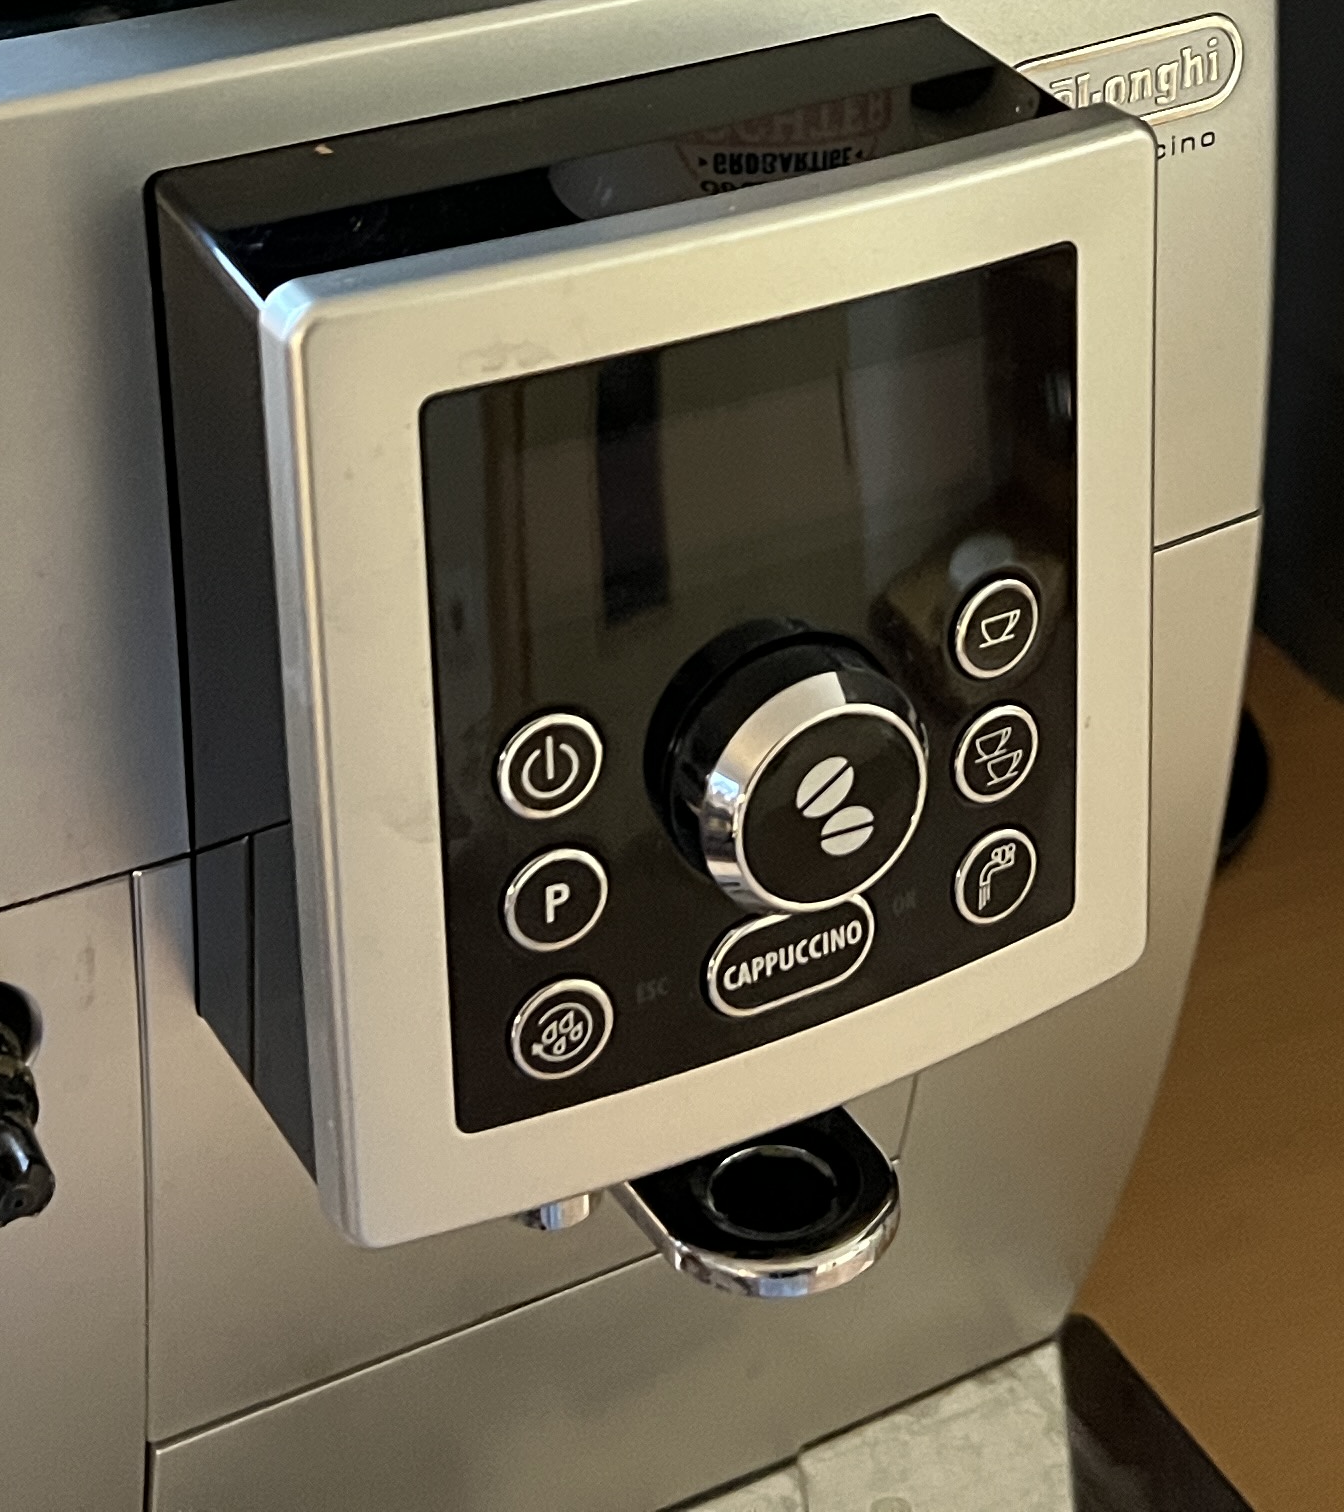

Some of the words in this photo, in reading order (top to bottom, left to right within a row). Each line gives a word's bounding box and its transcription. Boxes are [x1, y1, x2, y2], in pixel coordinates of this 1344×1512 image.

[545, 883, 570, 924] P
[723, 919, 863, 991] CAPPUCCINO
[636, 976, 669, 1004] ESC
